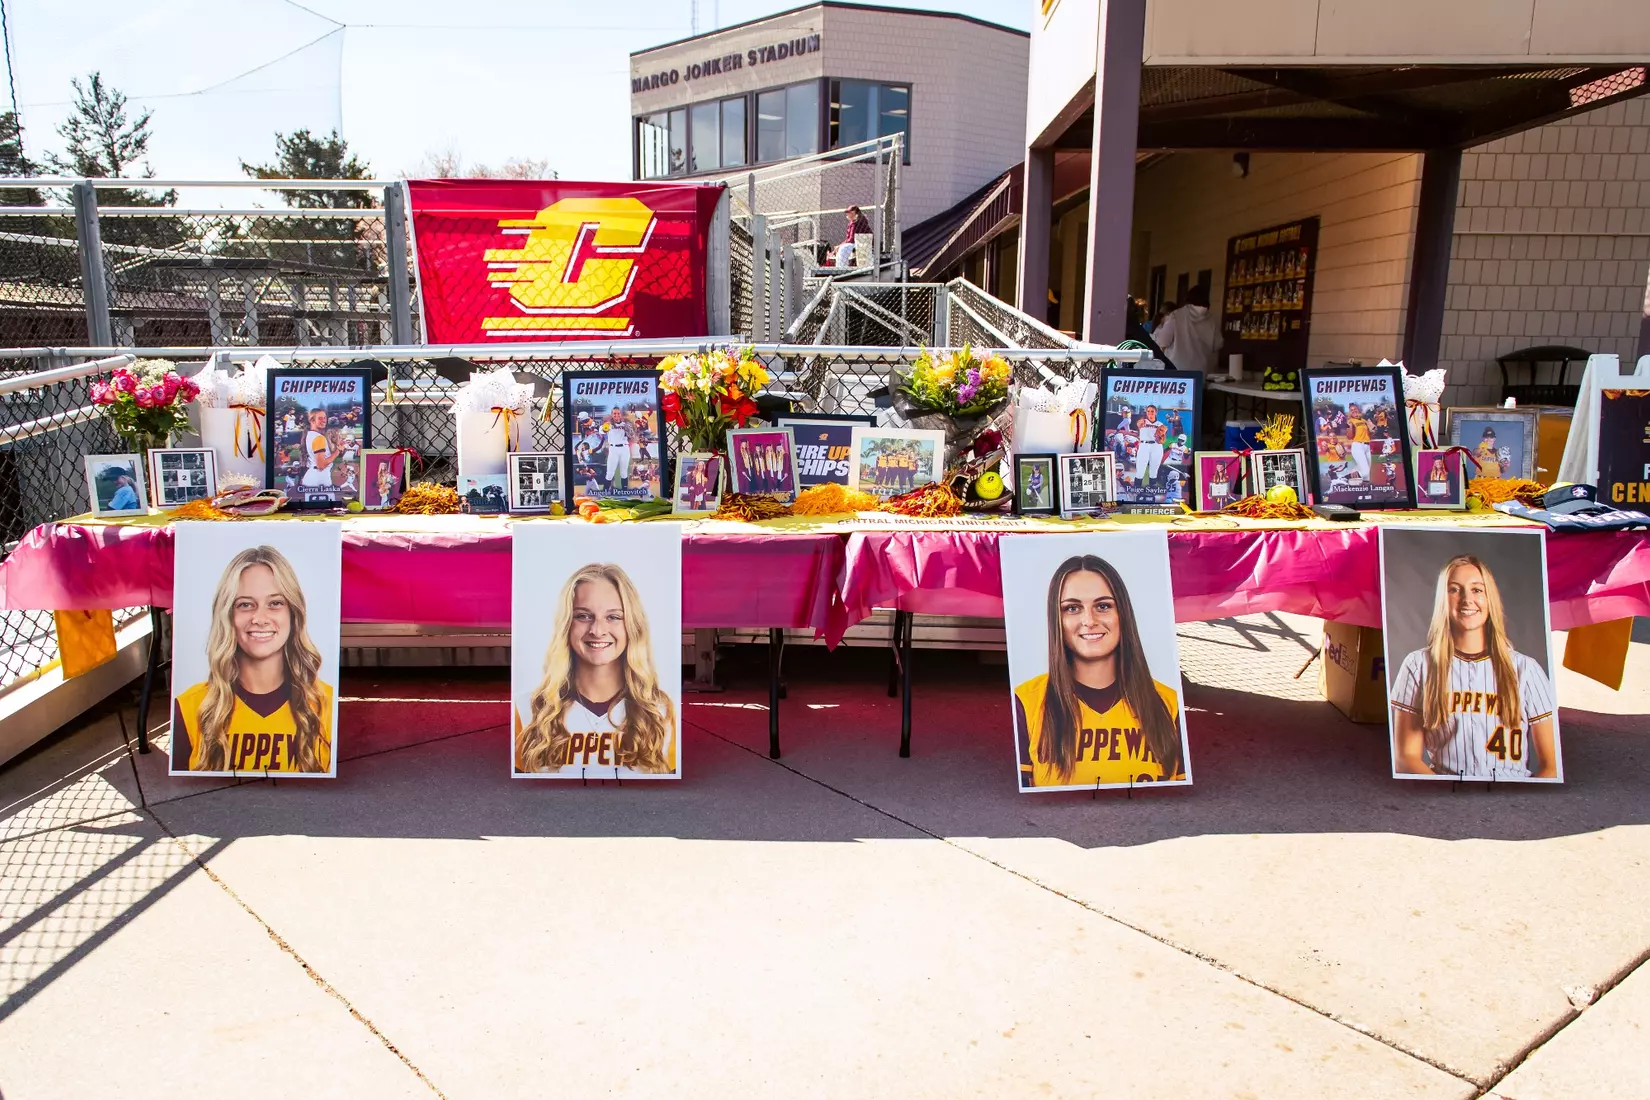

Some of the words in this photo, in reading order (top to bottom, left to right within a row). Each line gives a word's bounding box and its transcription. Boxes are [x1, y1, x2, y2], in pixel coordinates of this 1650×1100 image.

[632, 69, 679, 93] MARGO
[684, 54, 742, 81] JONKER
[747, 34, 820, 66] STADIUM
[281, 380, 356, 393] CHIPPEWAS
[576, 381, 649, 395] CHIPPEWAS
[1113, 380, 1187, 394] CHIPPEWAS
[1316, 379, 1387, 393] CHIPPEWAS
[828, 446, 852, 460] UP
[1145, 486, 1167, 494] Sayler
[1370, 484, 1394, 492] Langan
[838, 518, 891, 526] CENTRAL
[894, 518, 954, 526] MICHIGAN
[957, 519, 1027, 527] UNIVERSITY
[1450, 692, 1502, 716] PPEW
[1485, 726, 1523, 761] 40
[226, 733, 298, 770] IPPEW
